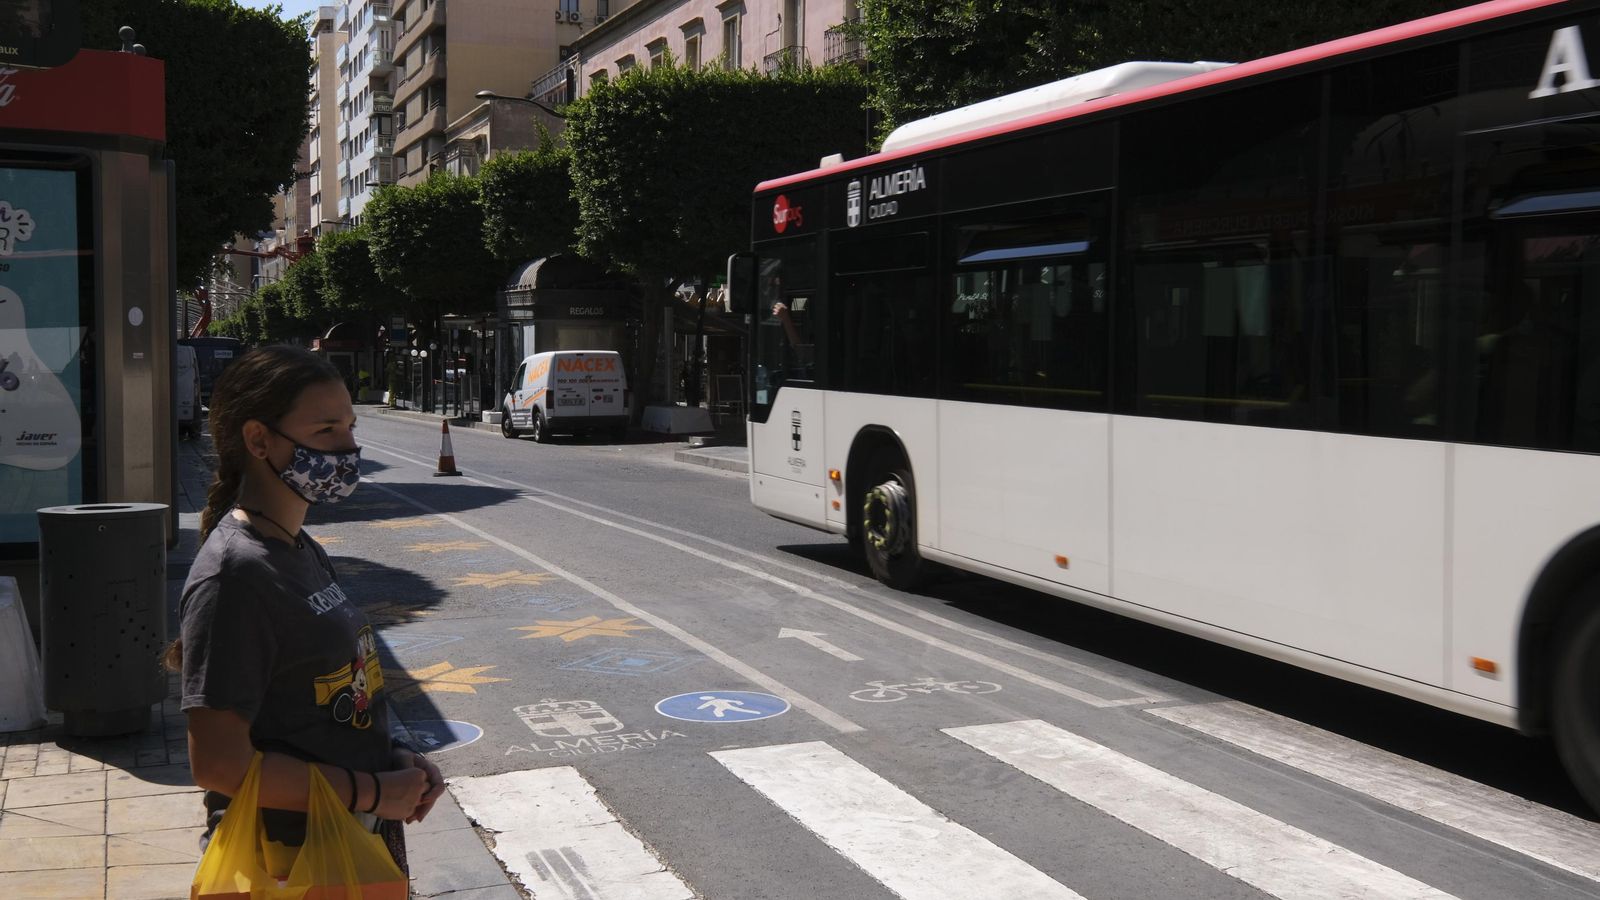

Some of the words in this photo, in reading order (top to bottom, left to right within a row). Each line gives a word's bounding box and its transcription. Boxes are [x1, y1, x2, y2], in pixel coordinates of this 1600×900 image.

[1528, 24, 1600, 99] A
[869, 163, 927, 201] ALMERÍA
[569, 307, 604, 316] REGALOS
[557, 358, 616, 372] NACEX
[504, 729, 688, 757] ALMERÍA
[548, 742, 656, 758] CIUDAD
